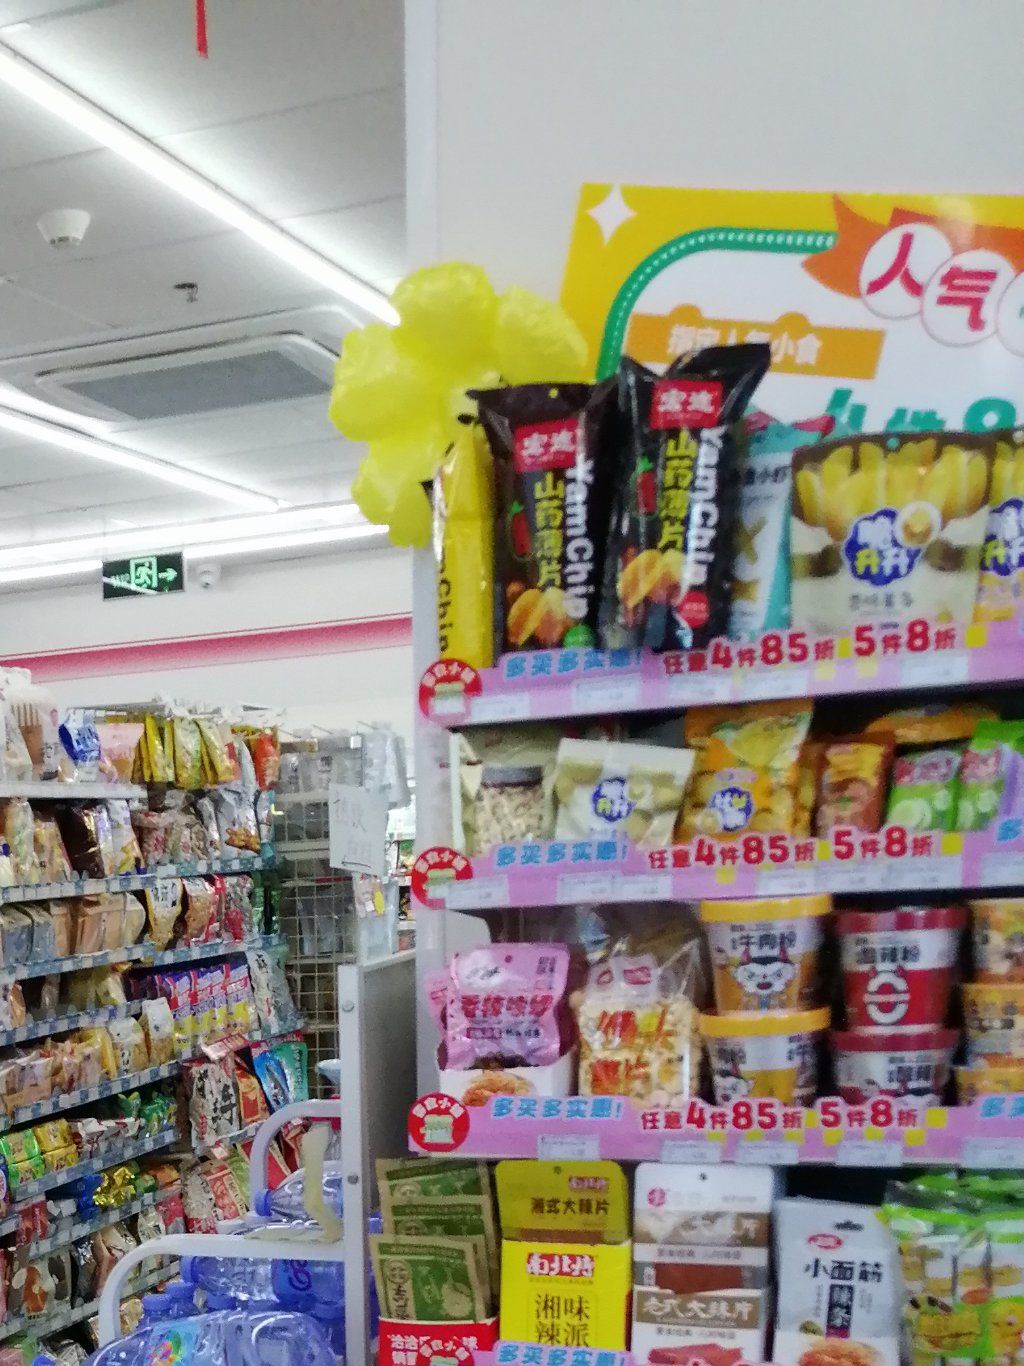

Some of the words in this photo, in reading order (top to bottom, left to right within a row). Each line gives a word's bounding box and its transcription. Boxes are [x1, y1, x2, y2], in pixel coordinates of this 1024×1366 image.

[865, 232, 999, 333] 人气
[854, 617, 957, 658] 5件8折
[648, 829, 815, 872] 任意4件85折
[832, 824, 934, 860] 5件8折
[491, 1097, 623, 1120] 多买多实惠!
[640, 1099, 806, 1131] 任意4件85折
[820, 1099, 919, 1130] 5件8折
[802, 1256, 884, 1284] 小面筋
[534, 1292, 591, 1322] 湘味
[534, 1321, 591, 1348] 辣派
